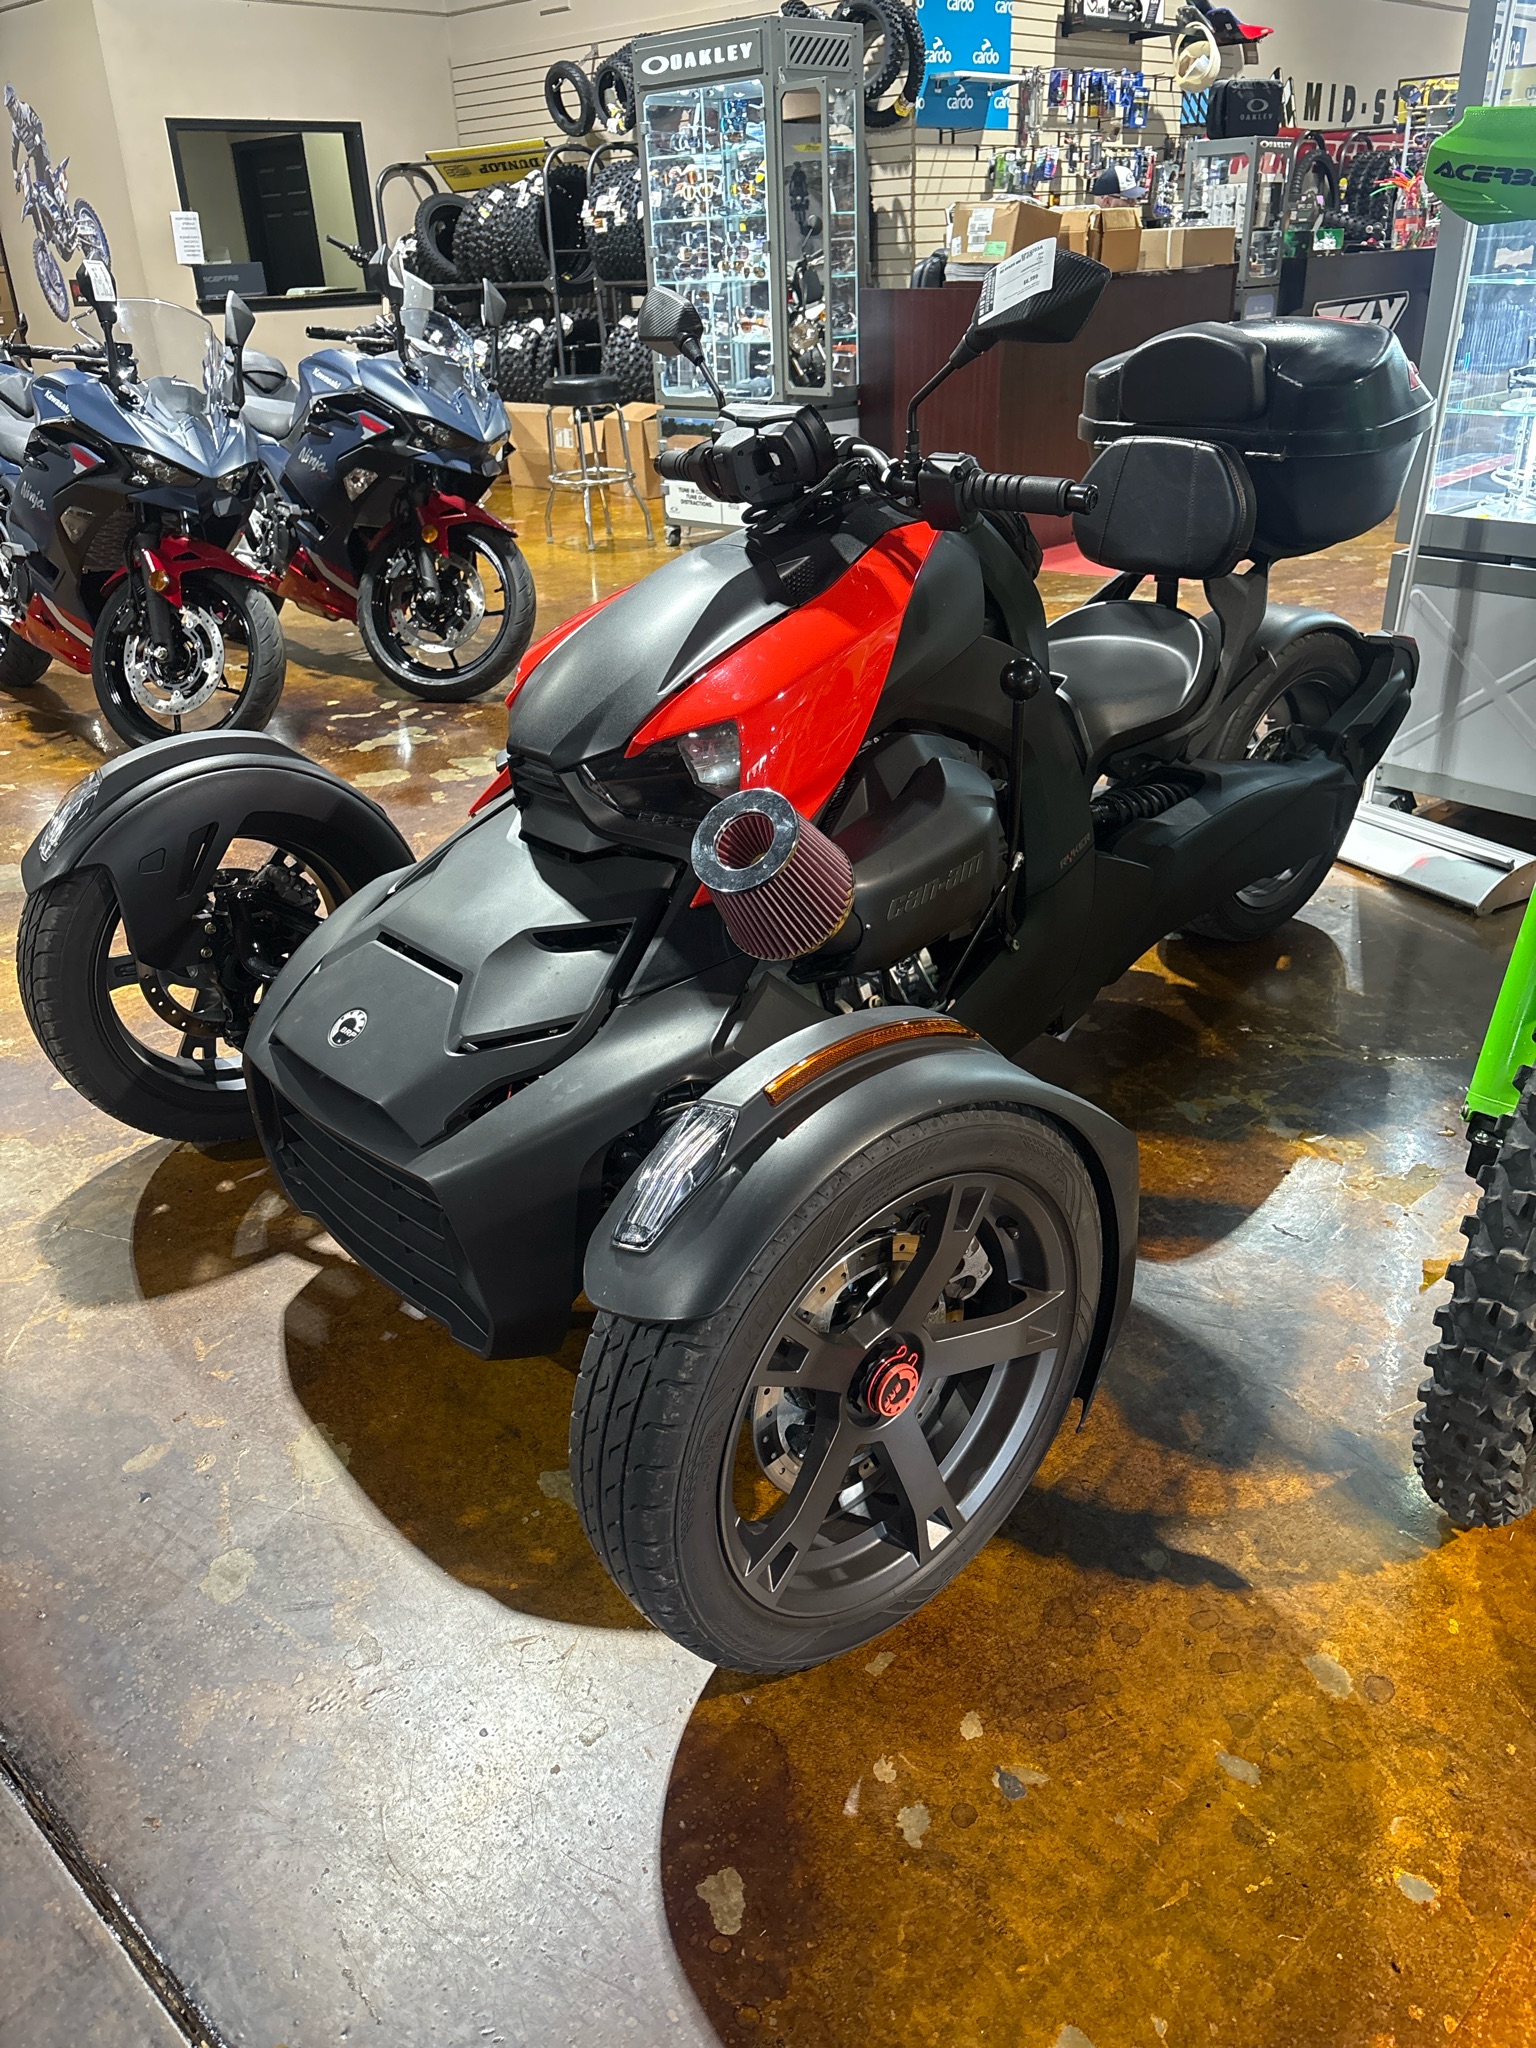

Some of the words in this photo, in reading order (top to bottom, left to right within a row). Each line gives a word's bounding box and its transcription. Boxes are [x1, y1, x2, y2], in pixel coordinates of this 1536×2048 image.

[995, 1, 1012, 13] car
[669, 42, 753, 71] OAKLEY
[972, 48, 999, 64] cardo
[947, 94, 973, 109] cardo
[994, 97, 1010, 109] car
[479, 157, 541, 174] DUNLOP
[312, 367, 342, 390] Kawasaki
[298, 446, 328, 473] Ninja
[20, 480, 46, 511] Ninja
[680, 499, 714, 508] DISTRACTIONS.
[1059, 833, 1091, 869] RYKER
[887, 851, 984, 922] can-am
